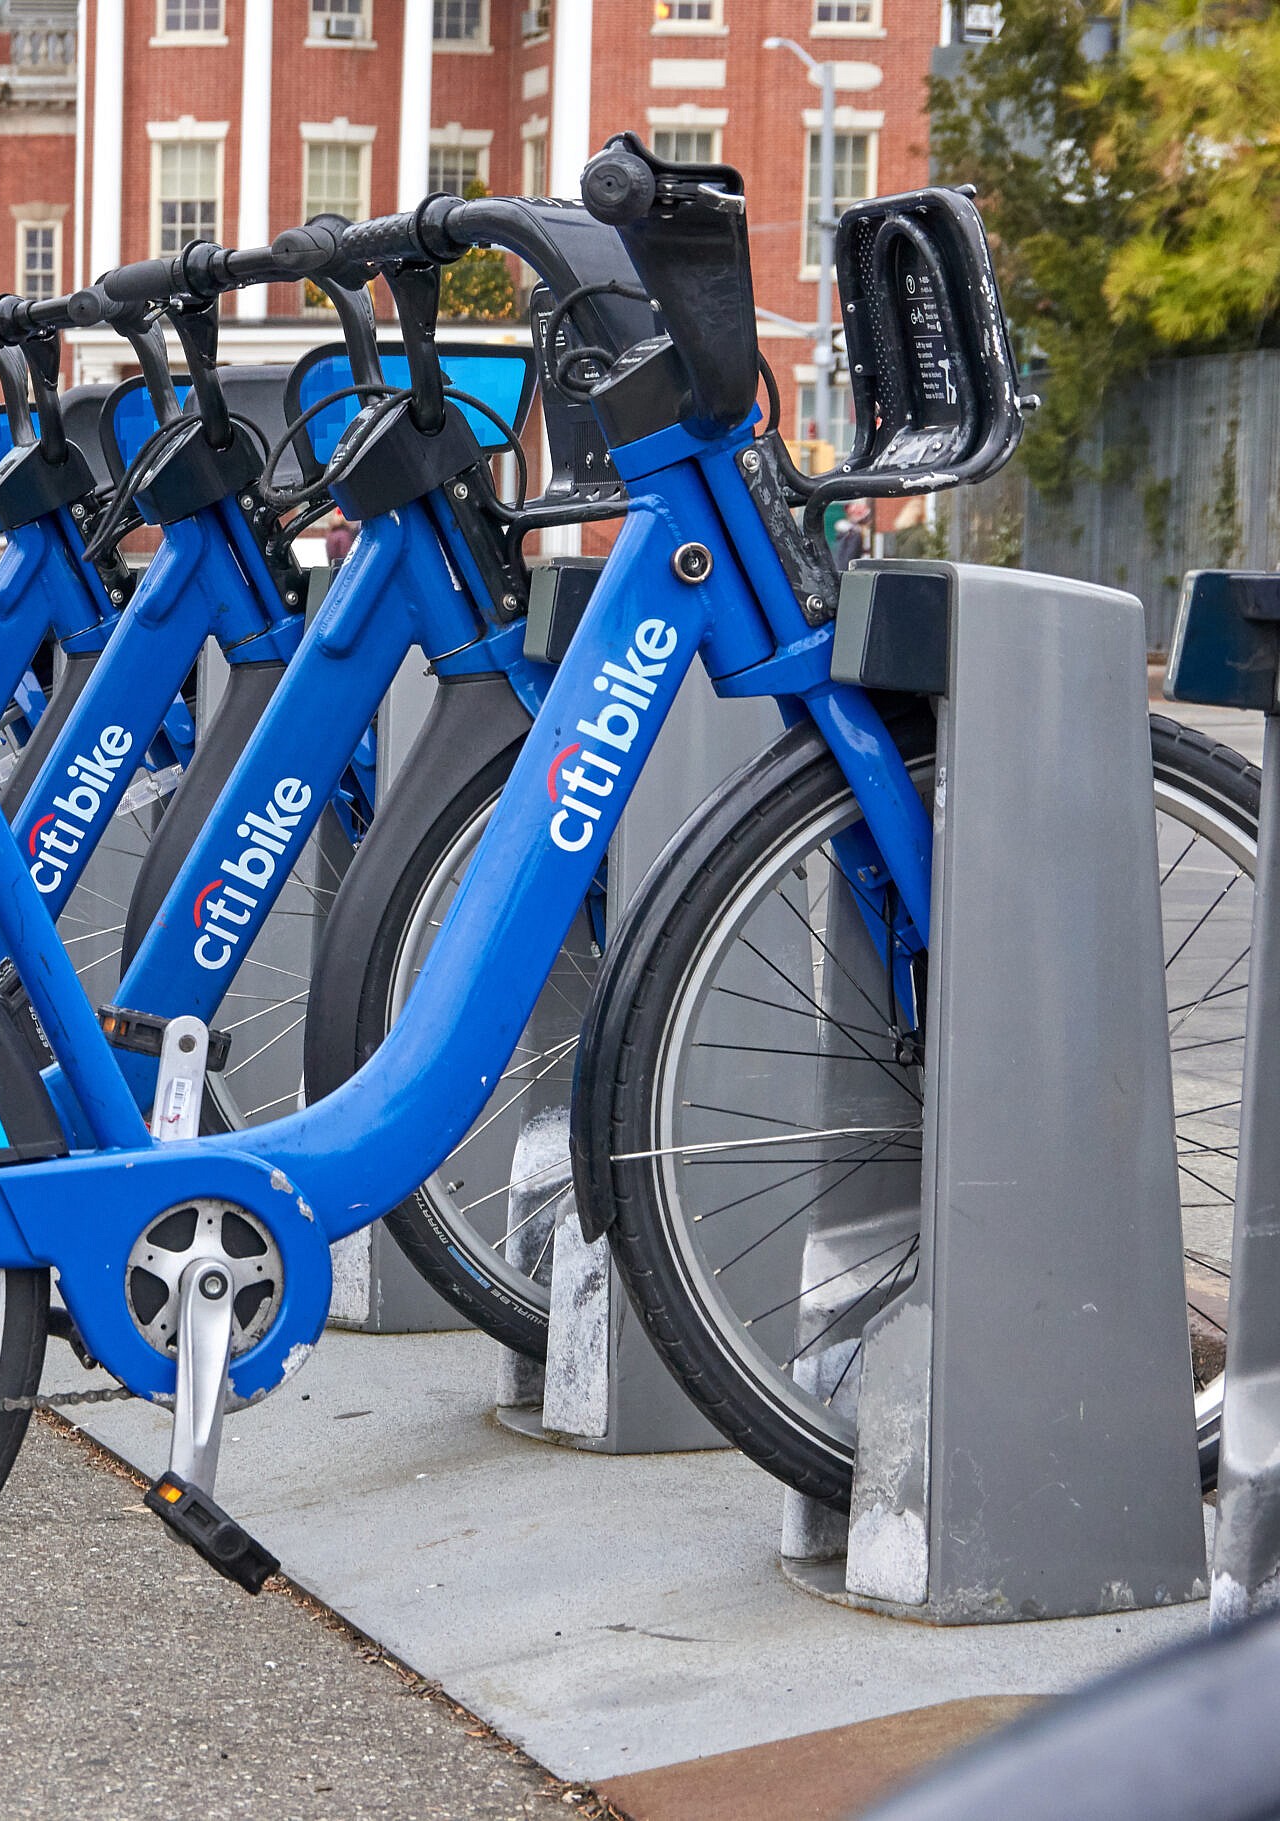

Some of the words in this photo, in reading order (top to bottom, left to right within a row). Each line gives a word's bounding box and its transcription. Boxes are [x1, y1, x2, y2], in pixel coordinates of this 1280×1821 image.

[576, 618, 678, 753] bike
[53, 725, 133, 823] bike
[547, 742, 621, 852] citi
[29, 813, 85, 893] citi
[220, 777, 312, 890] bike
[193, 879, 258, 970] citi
[414, 1192, 449, 1245] MARATH
[490, 1288, 548, 1328] HWALBE
